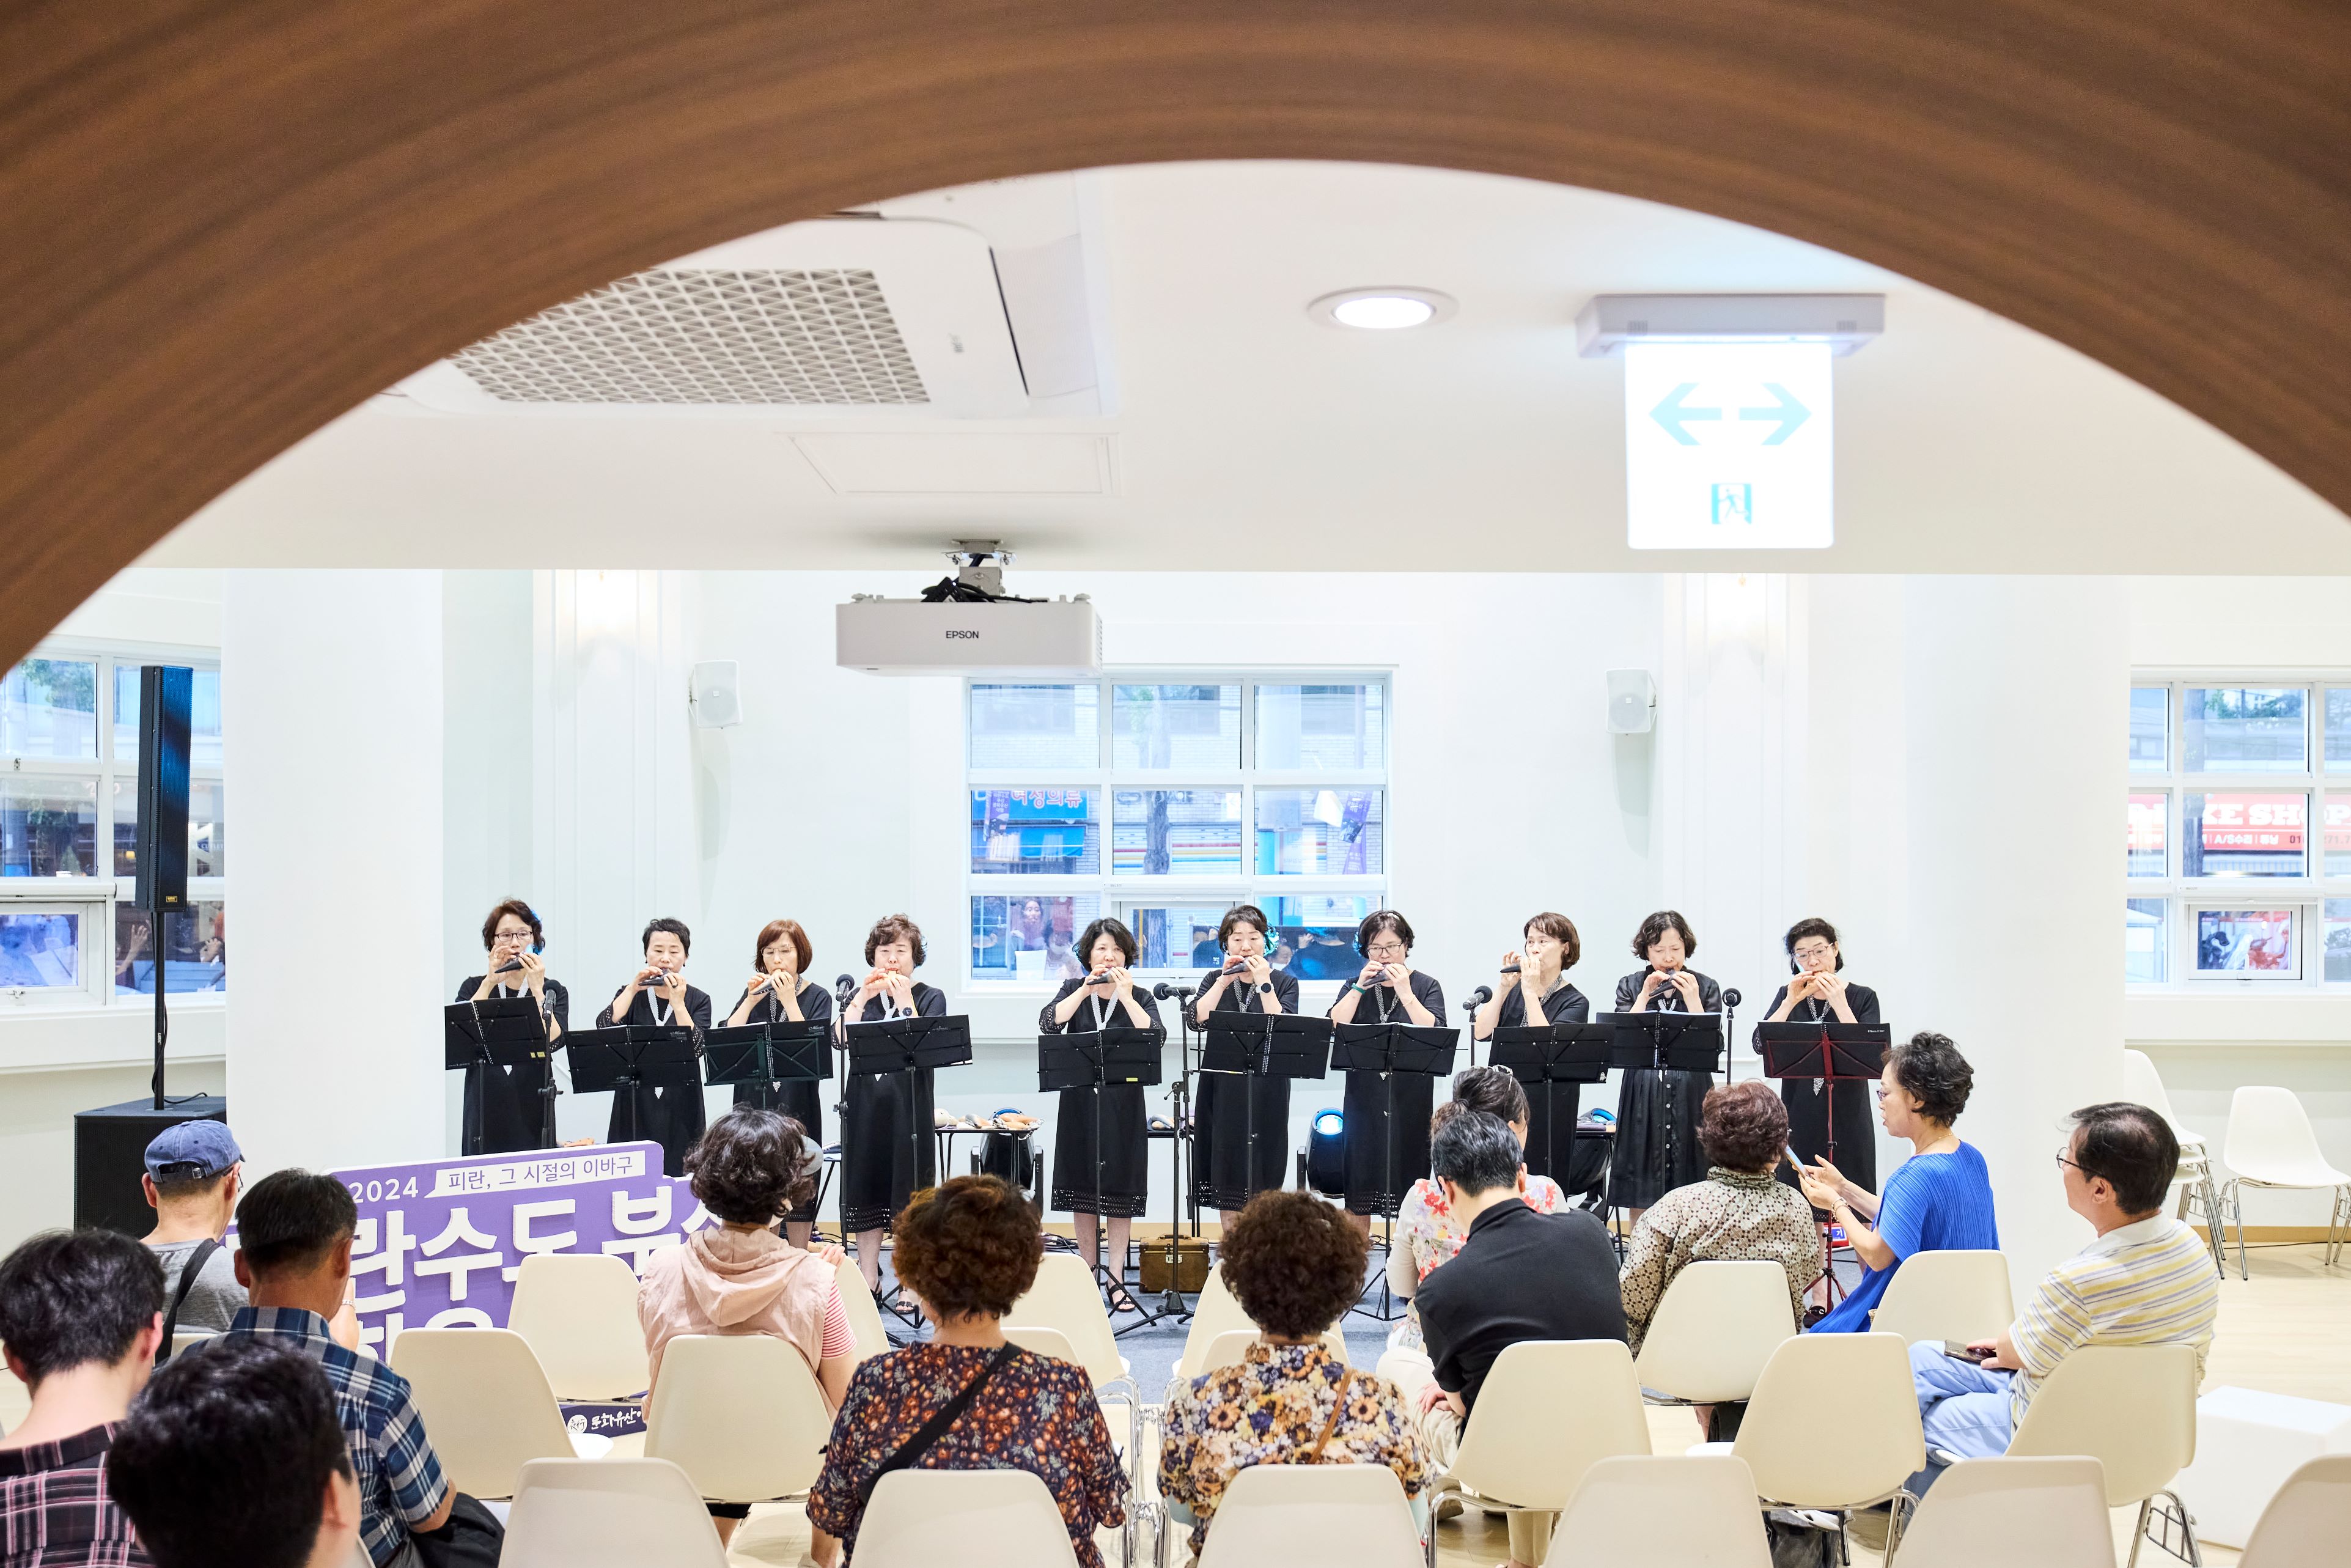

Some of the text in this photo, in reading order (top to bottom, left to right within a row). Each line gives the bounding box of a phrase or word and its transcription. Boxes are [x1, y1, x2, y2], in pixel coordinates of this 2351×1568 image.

[1012, 790, 1081, 806] 여성의류
[449, 1156, 633, 1191] 피란, 그 시절의 이바구
[348, 1176, 419, 1204] 2024
[350, 1198, 578, 1314] 란수도
